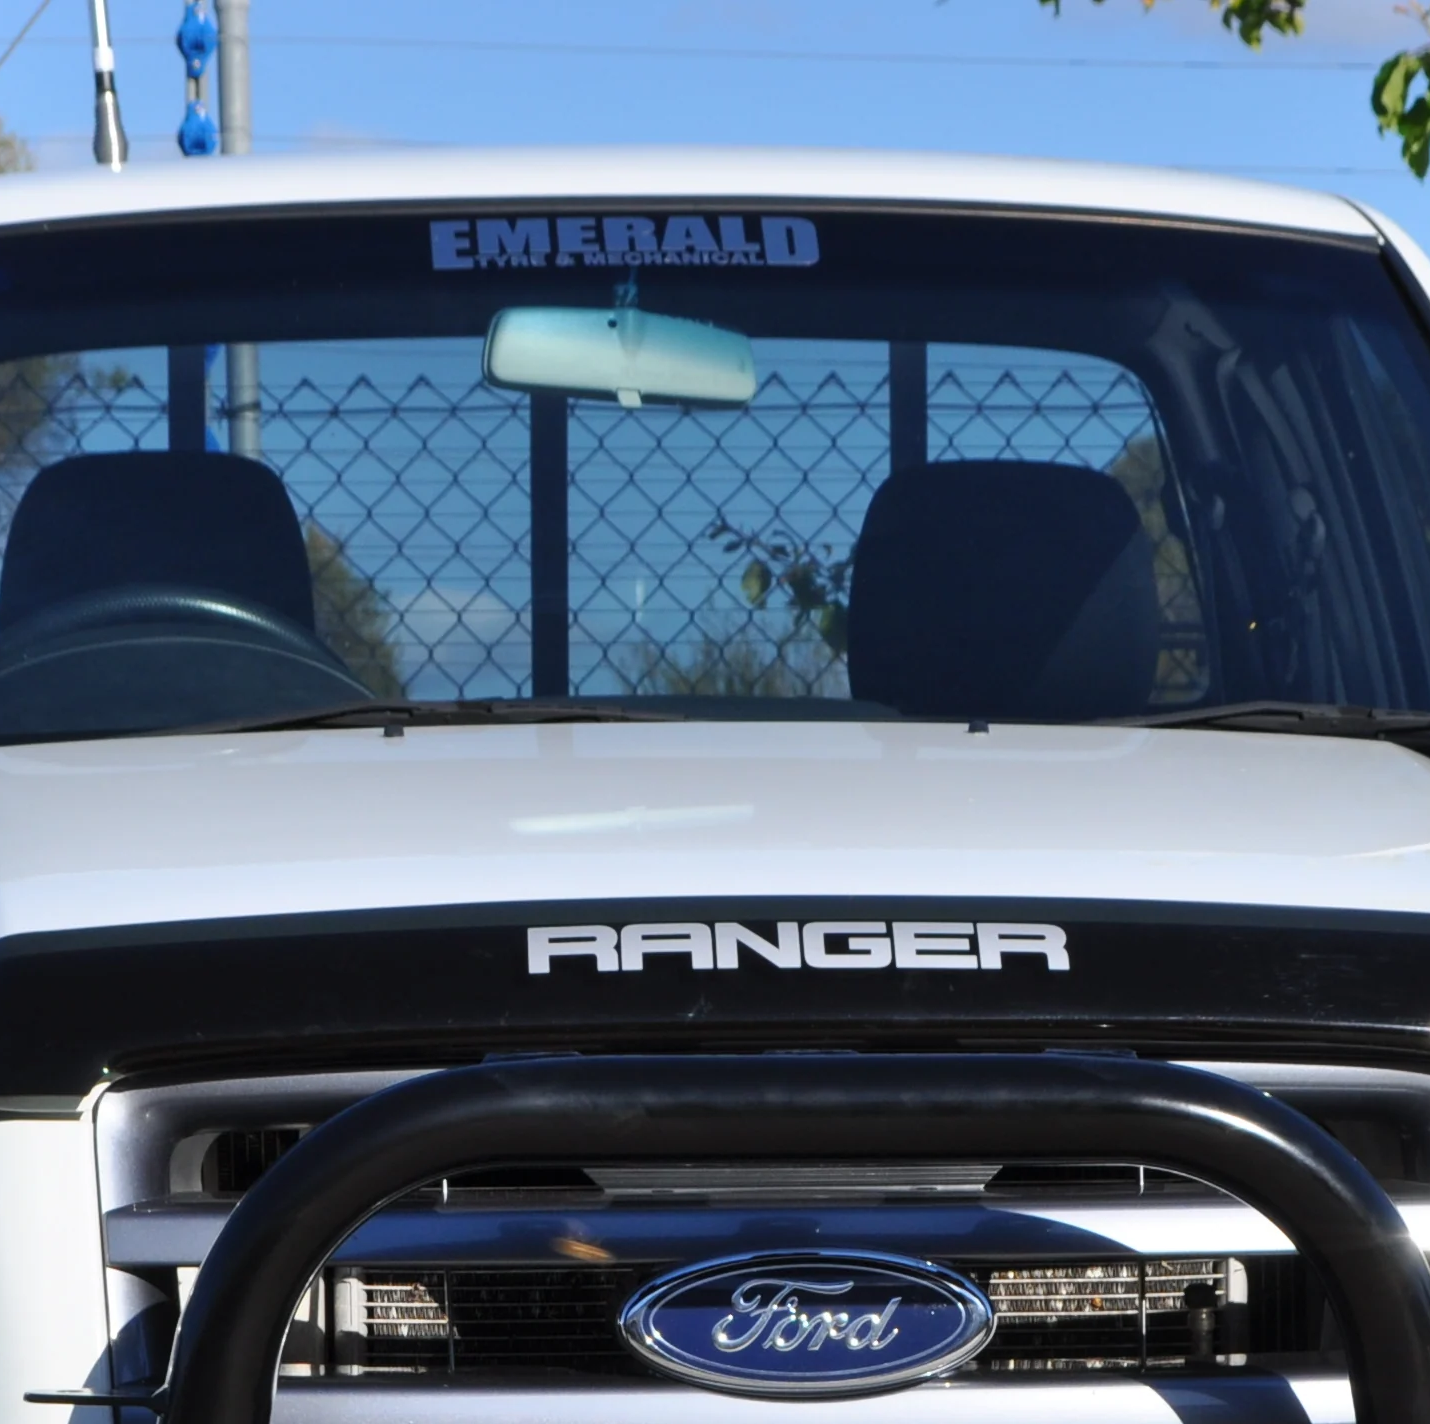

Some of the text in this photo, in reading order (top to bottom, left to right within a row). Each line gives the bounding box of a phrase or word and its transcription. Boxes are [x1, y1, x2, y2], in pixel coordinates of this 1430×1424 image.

[429, 215, 820, 271] EMERALD
[527, 922, 1071, 975] RANGER
[711, 1278, 903, 1352] Ford
